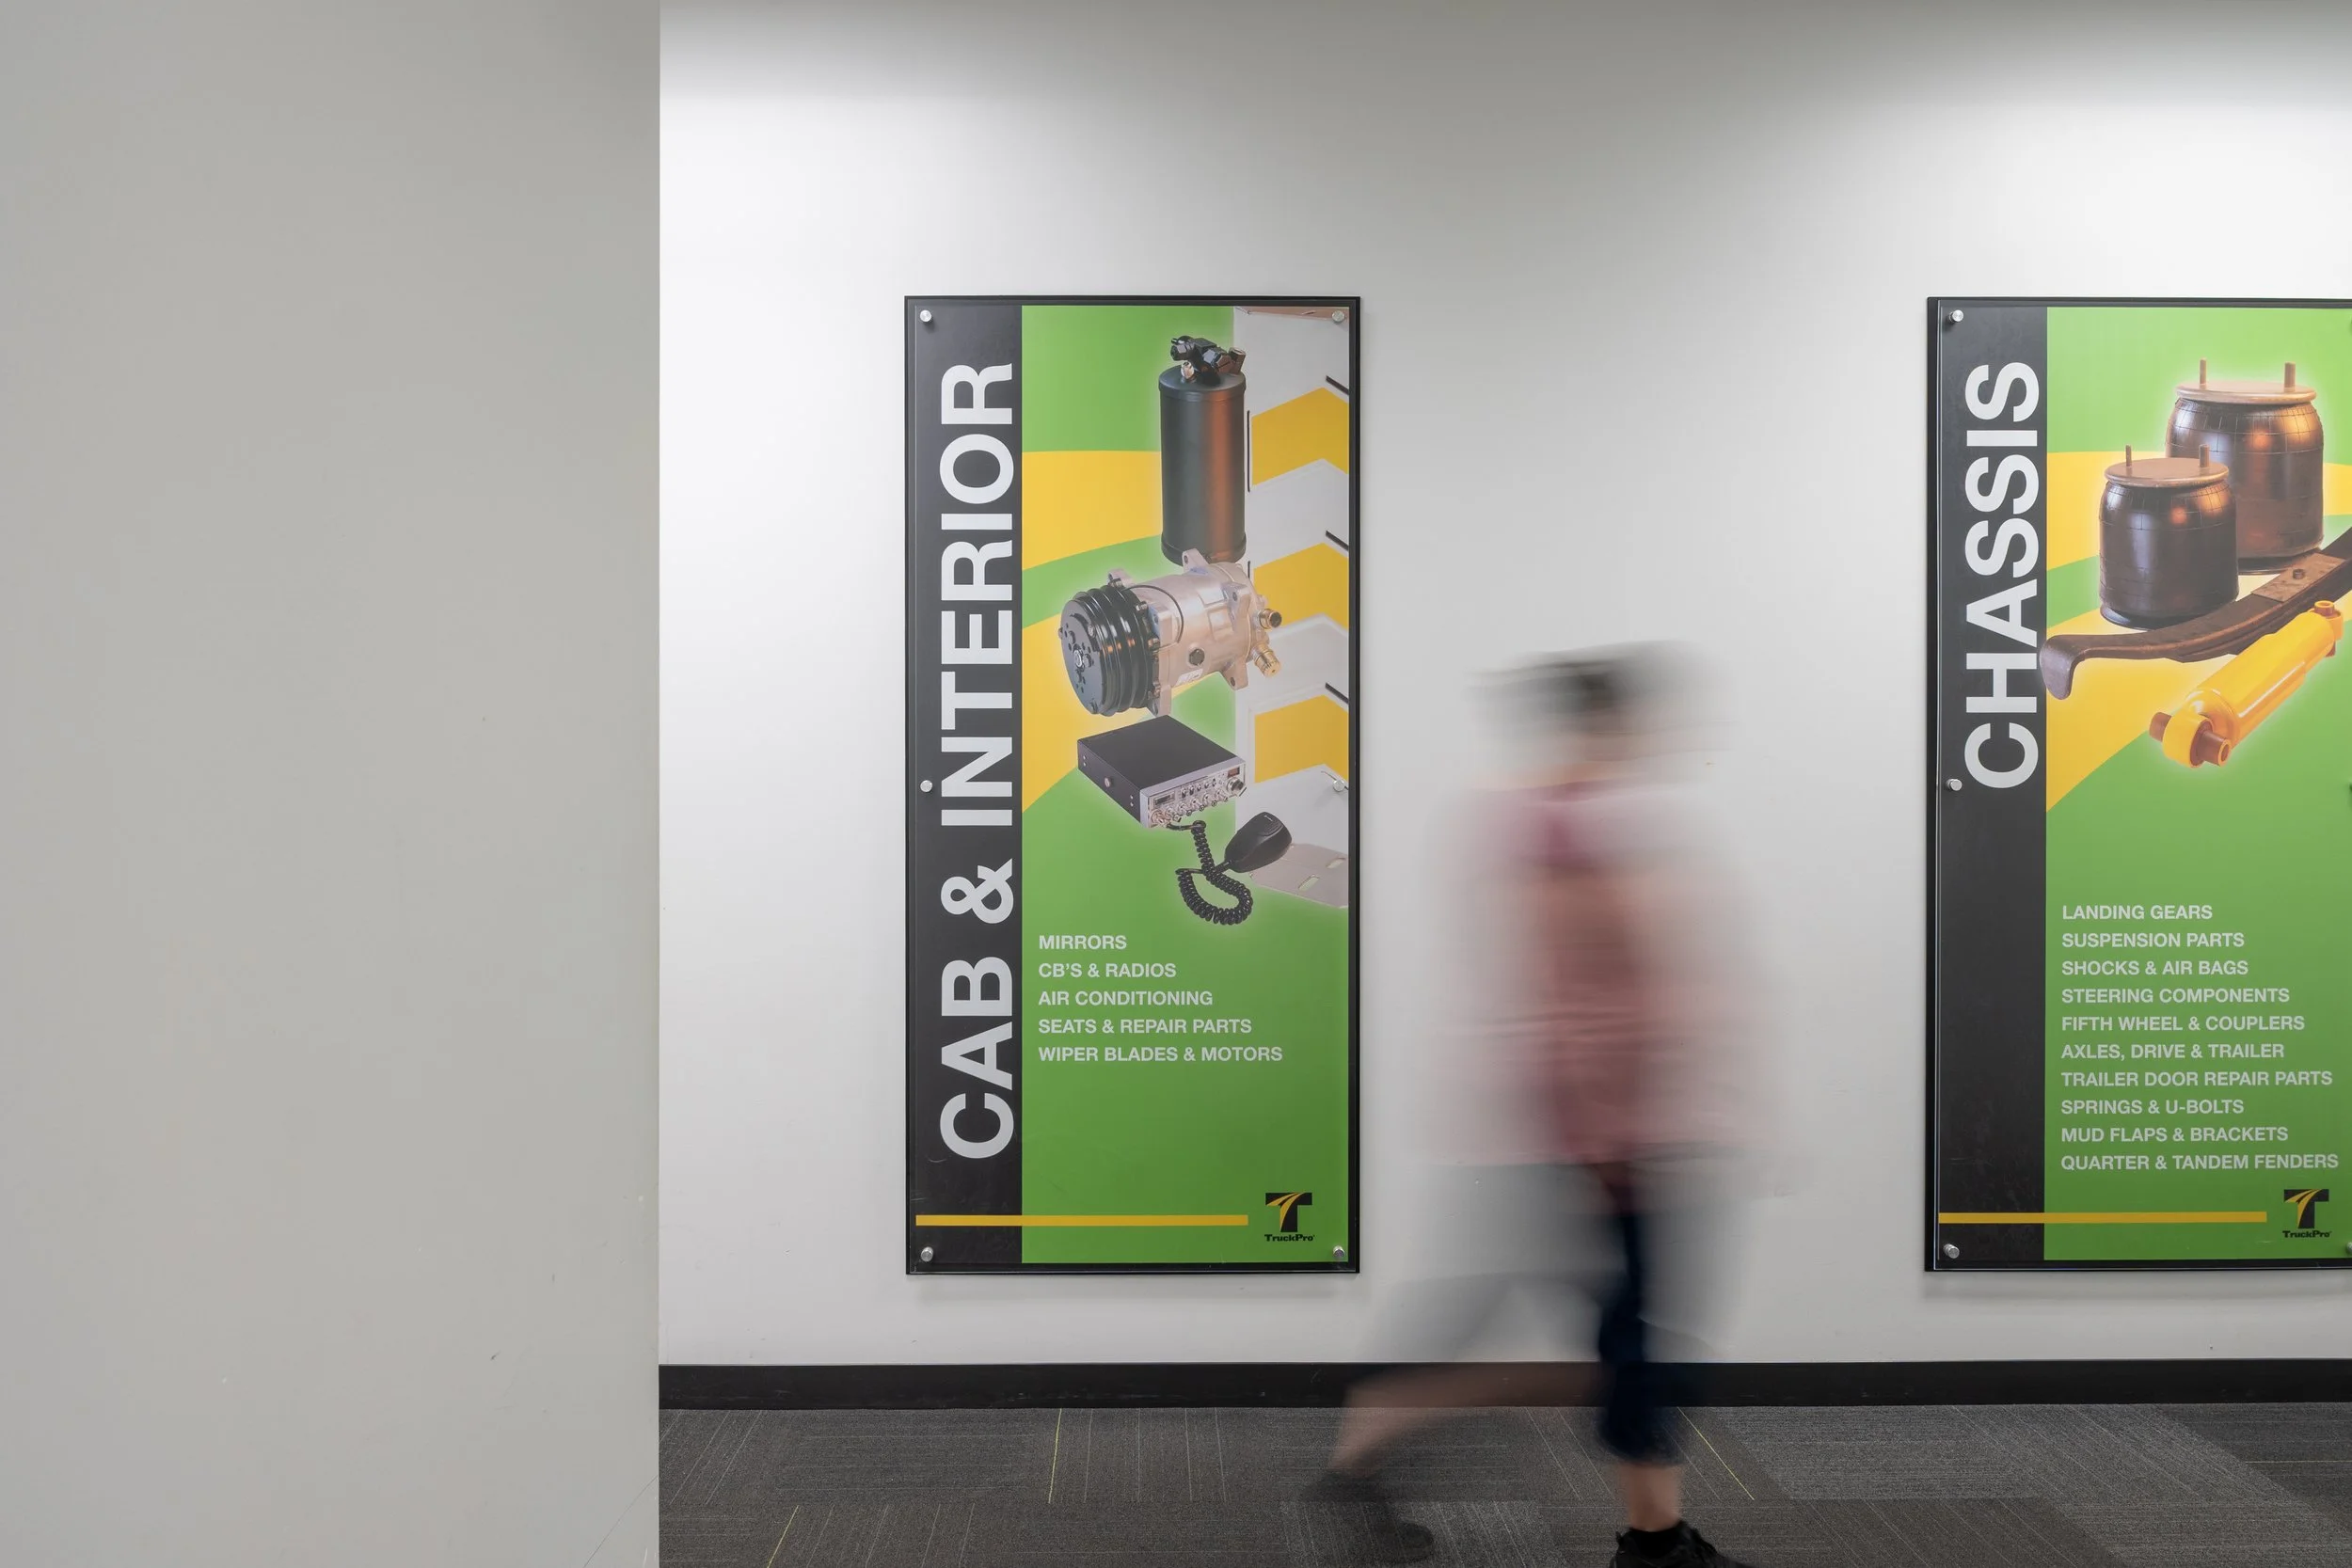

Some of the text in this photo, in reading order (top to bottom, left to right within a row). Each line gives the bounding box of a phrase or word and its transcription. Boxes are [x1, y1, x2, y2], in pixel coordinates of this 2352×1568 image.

[1964, 361, 2040, 789] CHASSIS
[940, 363, 1014, 1159] CAB & INTERIOR
[2061, 904, 2213, 920] LANDING GEARS
[1038, 934, 1127, 950] MIRRORS
[2061, 932, 2244, 949] SUSPENSION PARTS
[1038, 962, 1176, 978] CB'S & RADIOS
[2061, 959, 2249, 976] SHOCKS & AIR BAGS
[1039, 990, 1214, 1006] AIR CONDITIONING
[2061, 987, 2289, 1005] STEERING COMPONENTS
[1038, 1018, 1252, 1035] SEATS & REPAIR PARTS
[2061, 1015, 2304, 1032] FIFTH WHEEL & COUPLERS
[1038, 1045, 1284, 1063] WIPER BLADES & MOTORS
[2061, 1042, 2285, 1060] AXLES, DRIVE & TRAILER
[2061, 1069, 2332, 1087] TRAILER DOOR REPAIR PARTS
[2061, 1098, 2244, 1115] SPRINGS & U-BOLTS
[2061, 1126, 2289, 1144] MUD FLAPS & BRACKETS
[2060, 1153, 2339, 1171] QUARTER & TANDEM FENDERS
